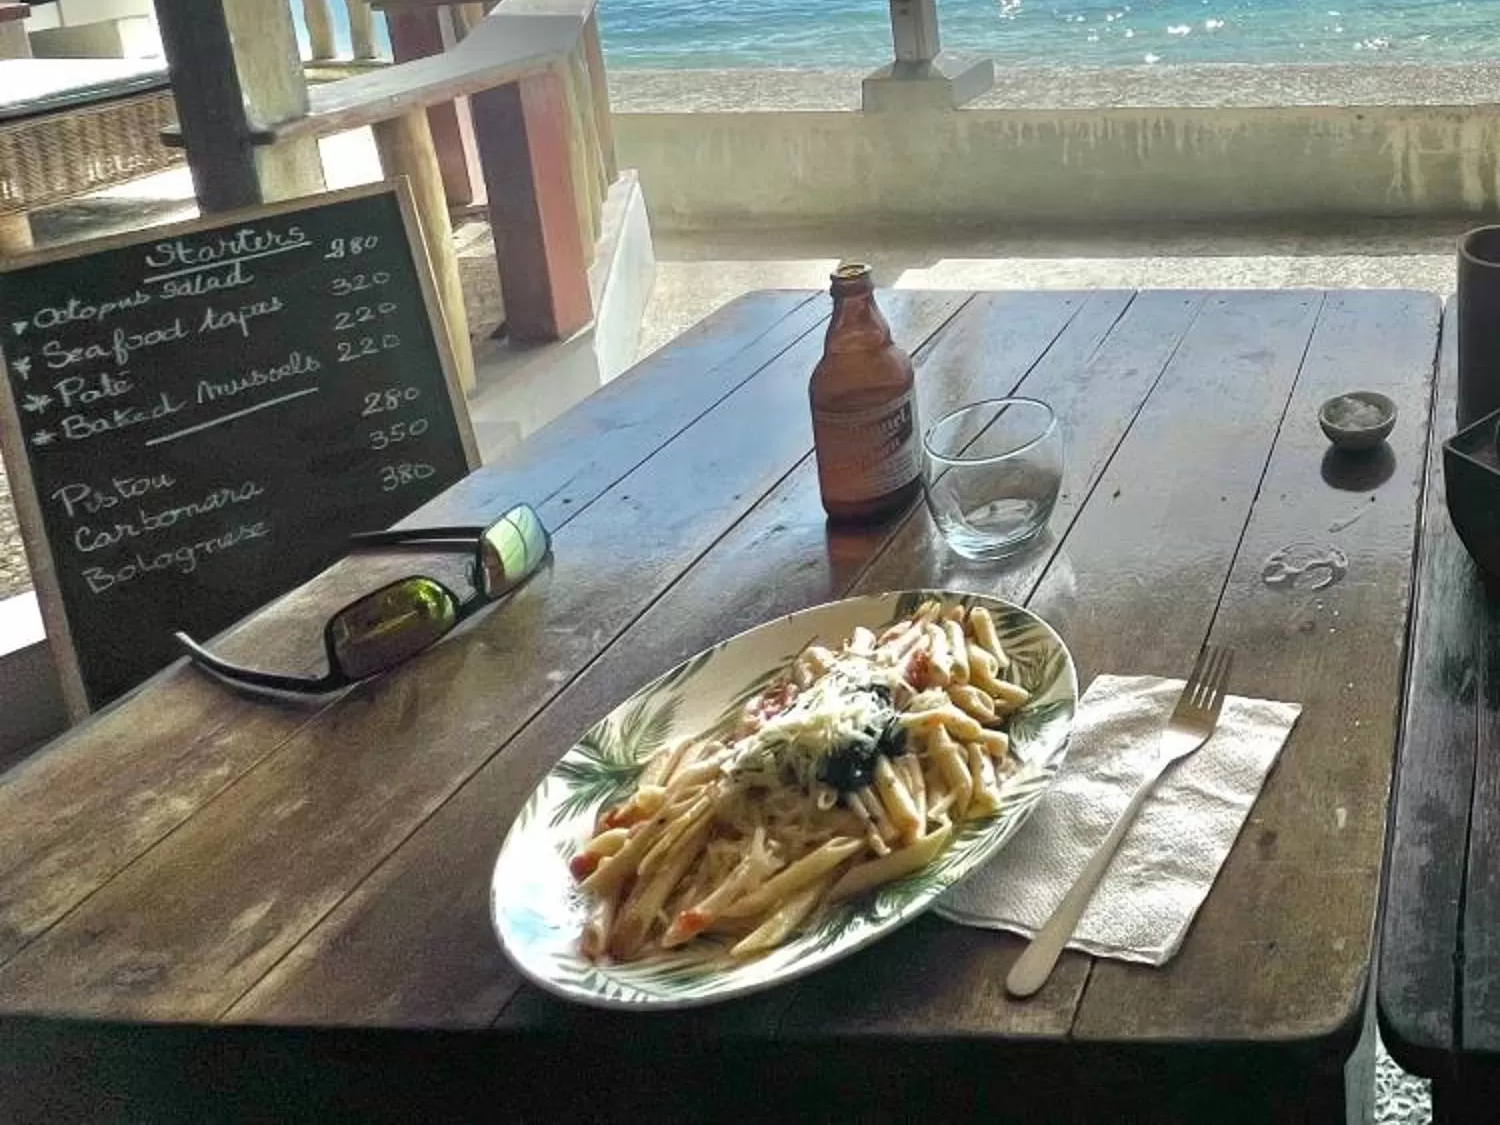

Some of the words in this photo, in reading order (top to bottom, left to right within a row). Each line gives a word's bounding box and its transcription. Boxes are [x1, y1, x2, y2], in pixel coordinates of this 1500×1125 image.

[144, 226, 306, 268] Starters
[331, 271, 390, 296] 320
[333, 302, 396, 331] 220
[62, 392, 188, 440] Baked
[336, 334, 400, 362] 220
[361, 386, 421, 416] 280
[75, 480, 265, 552] Carbonara
[369, 418, 430, 450] 350
[381, 463, 435, 492] 380
